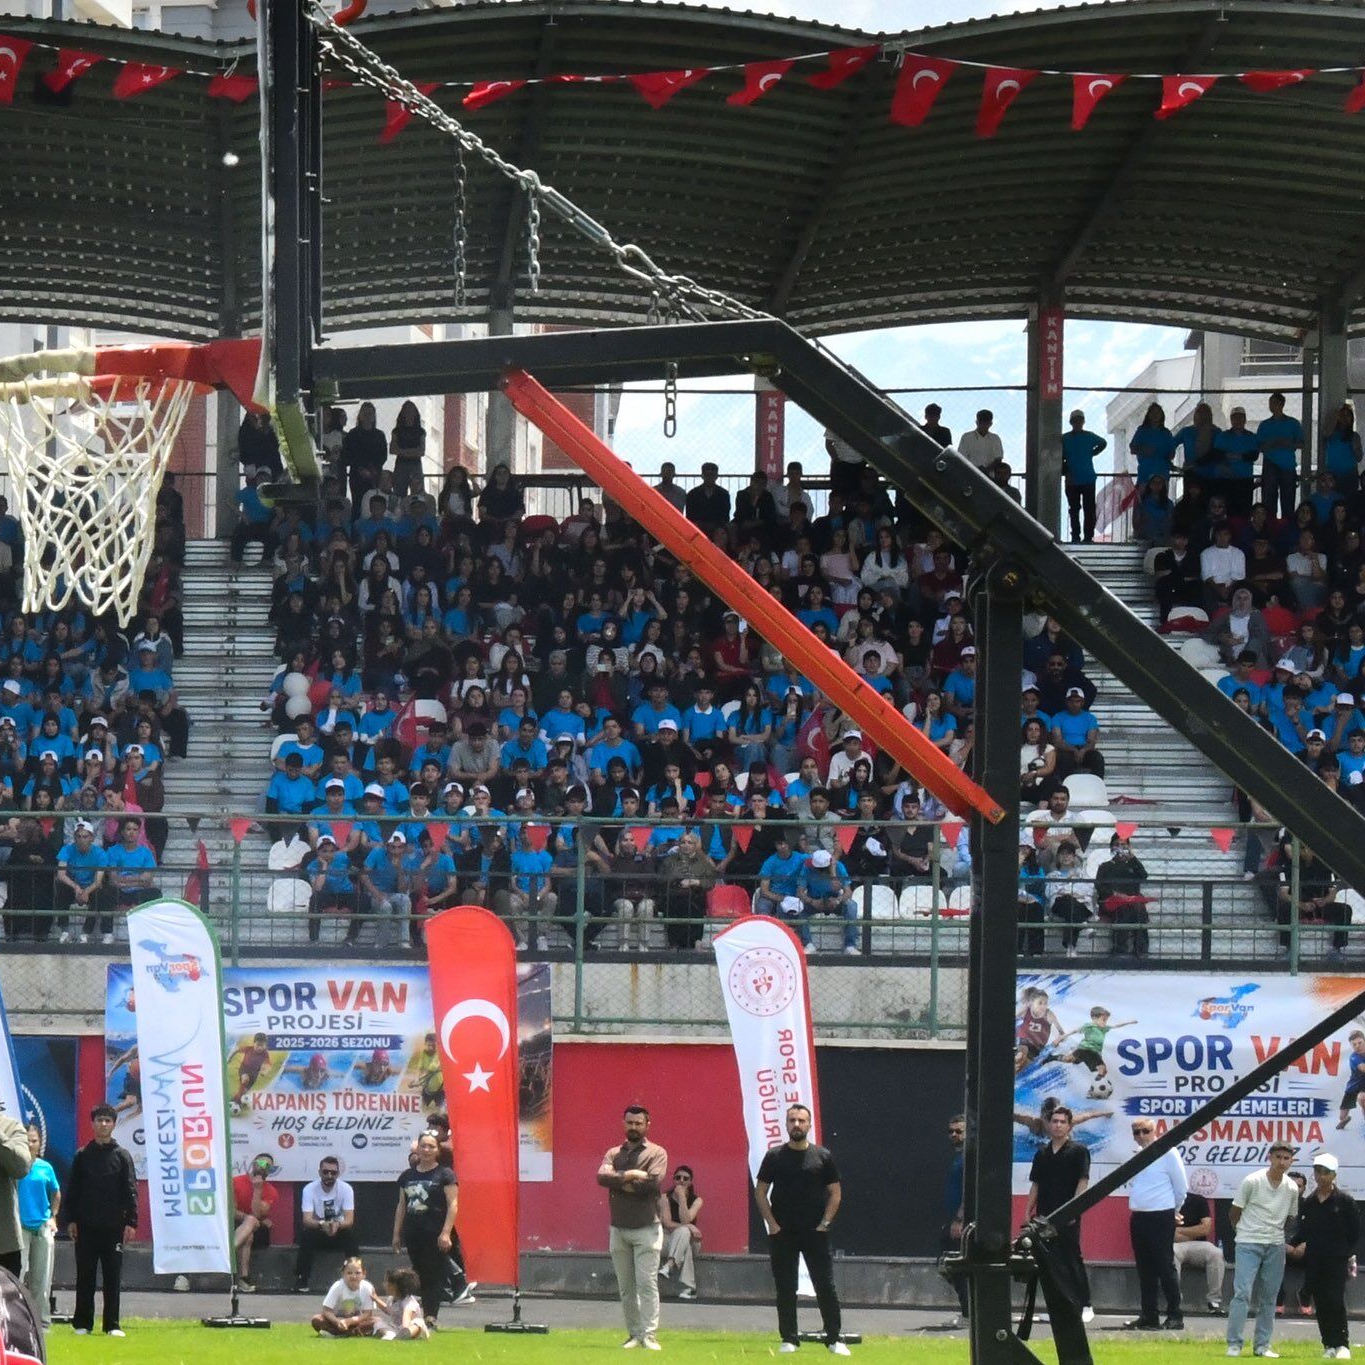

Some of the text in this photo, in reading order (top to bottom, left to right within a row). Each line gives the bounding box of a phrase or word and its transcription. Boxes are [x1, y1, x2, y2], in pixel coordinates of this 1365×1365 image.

[767, 397, 778, 473] KANTİN
[223, 980, 408, 1017] SPOR VAN
[267, 1012, 363, 1031] PROJESİ
[275, 1037, 391, 1049] 2025-2026 SEZONU
[1116, 1035, 1234, 1077] SPOR
[252, 1088, 420, 1114] KAPANIŞ TÖRENİNE
[1139, 1099, 1186, 1114] SPOR
[271, 1114, 395, 1132] HOŞ GELDİNİZ
